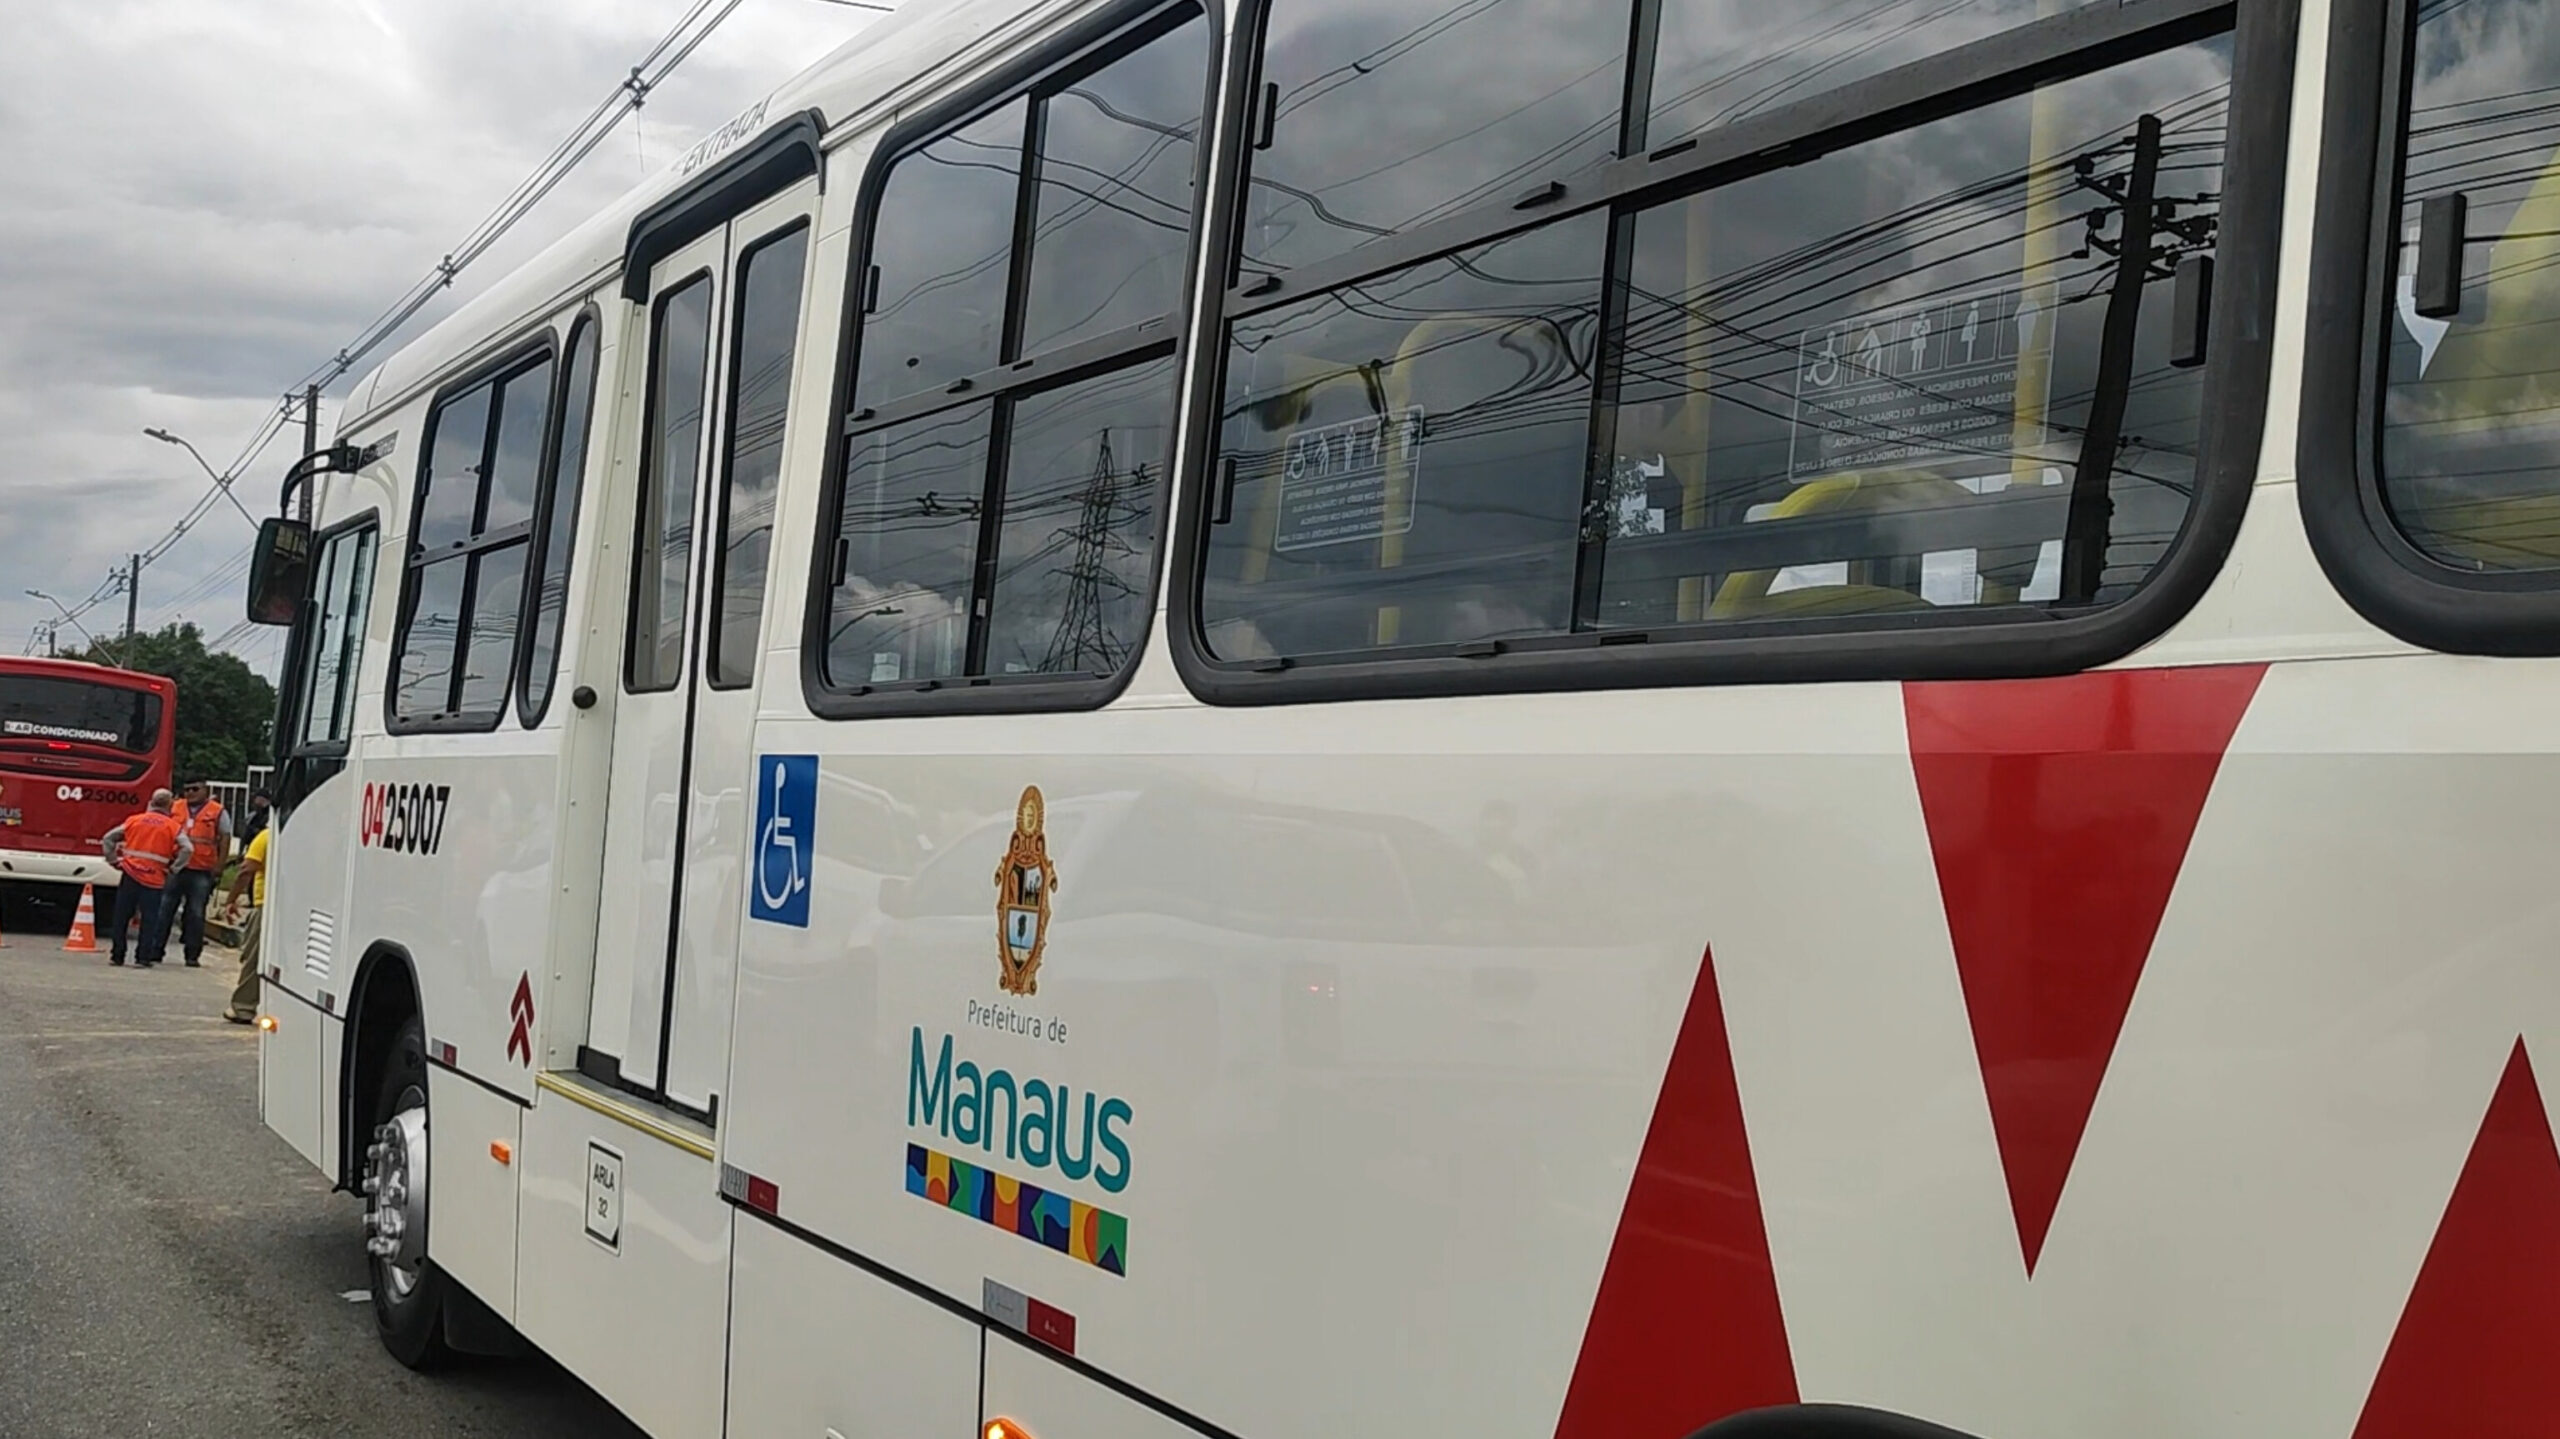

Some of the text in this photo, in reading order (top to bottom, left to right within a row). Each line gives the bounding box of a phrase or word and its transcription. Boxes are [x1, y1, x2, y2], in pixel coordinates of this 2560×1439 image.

[681, 99, 771, 176] ENTRADA
[33, 724, 118, 742] CONDICIONADO
[362, 782, 451, 856] 0425007
[967, 999, 1068, 1044] Prefeitura de
[908, 1026, 1133, 1193] Manaus
[593, 1162, 615, 1192] ARLA
[598, 1197, 609, 1218] 32
